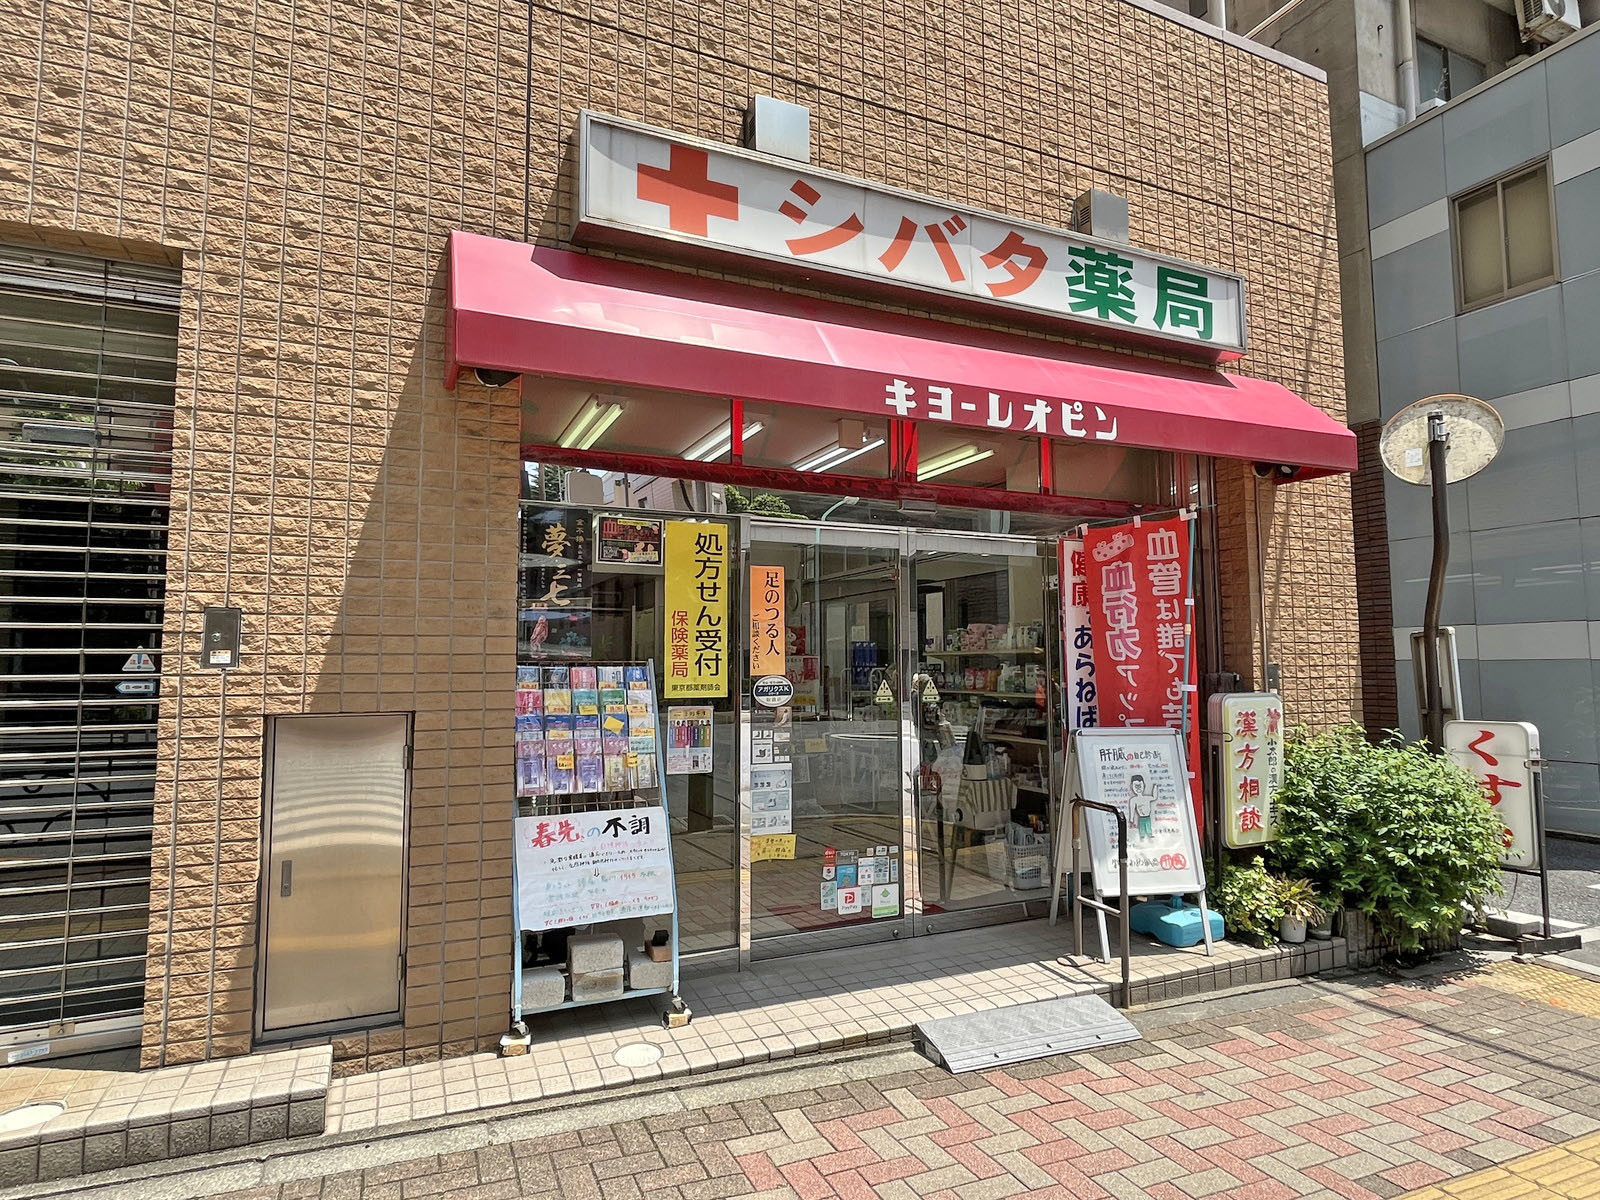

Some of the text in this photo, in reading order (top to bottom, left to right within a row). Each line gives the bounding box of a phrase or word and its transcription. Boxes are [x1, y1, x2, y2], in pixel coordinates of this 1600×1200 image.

[777, 179, 1213, 340] シバタ薬局
[885, 378, 1118, 441] キヨーレオピン
[694, 532, 723, 677] 処方せん受付
[751, 613, 761, 670] ご相談ください
[764, 571, 781, 656] 足のつる人
[671, 610, 689, 678] 保険薬局
[671, 683, 721, 692] 東京都薬剤師会
[1235, 711, 1264, 833] 漢方相談
